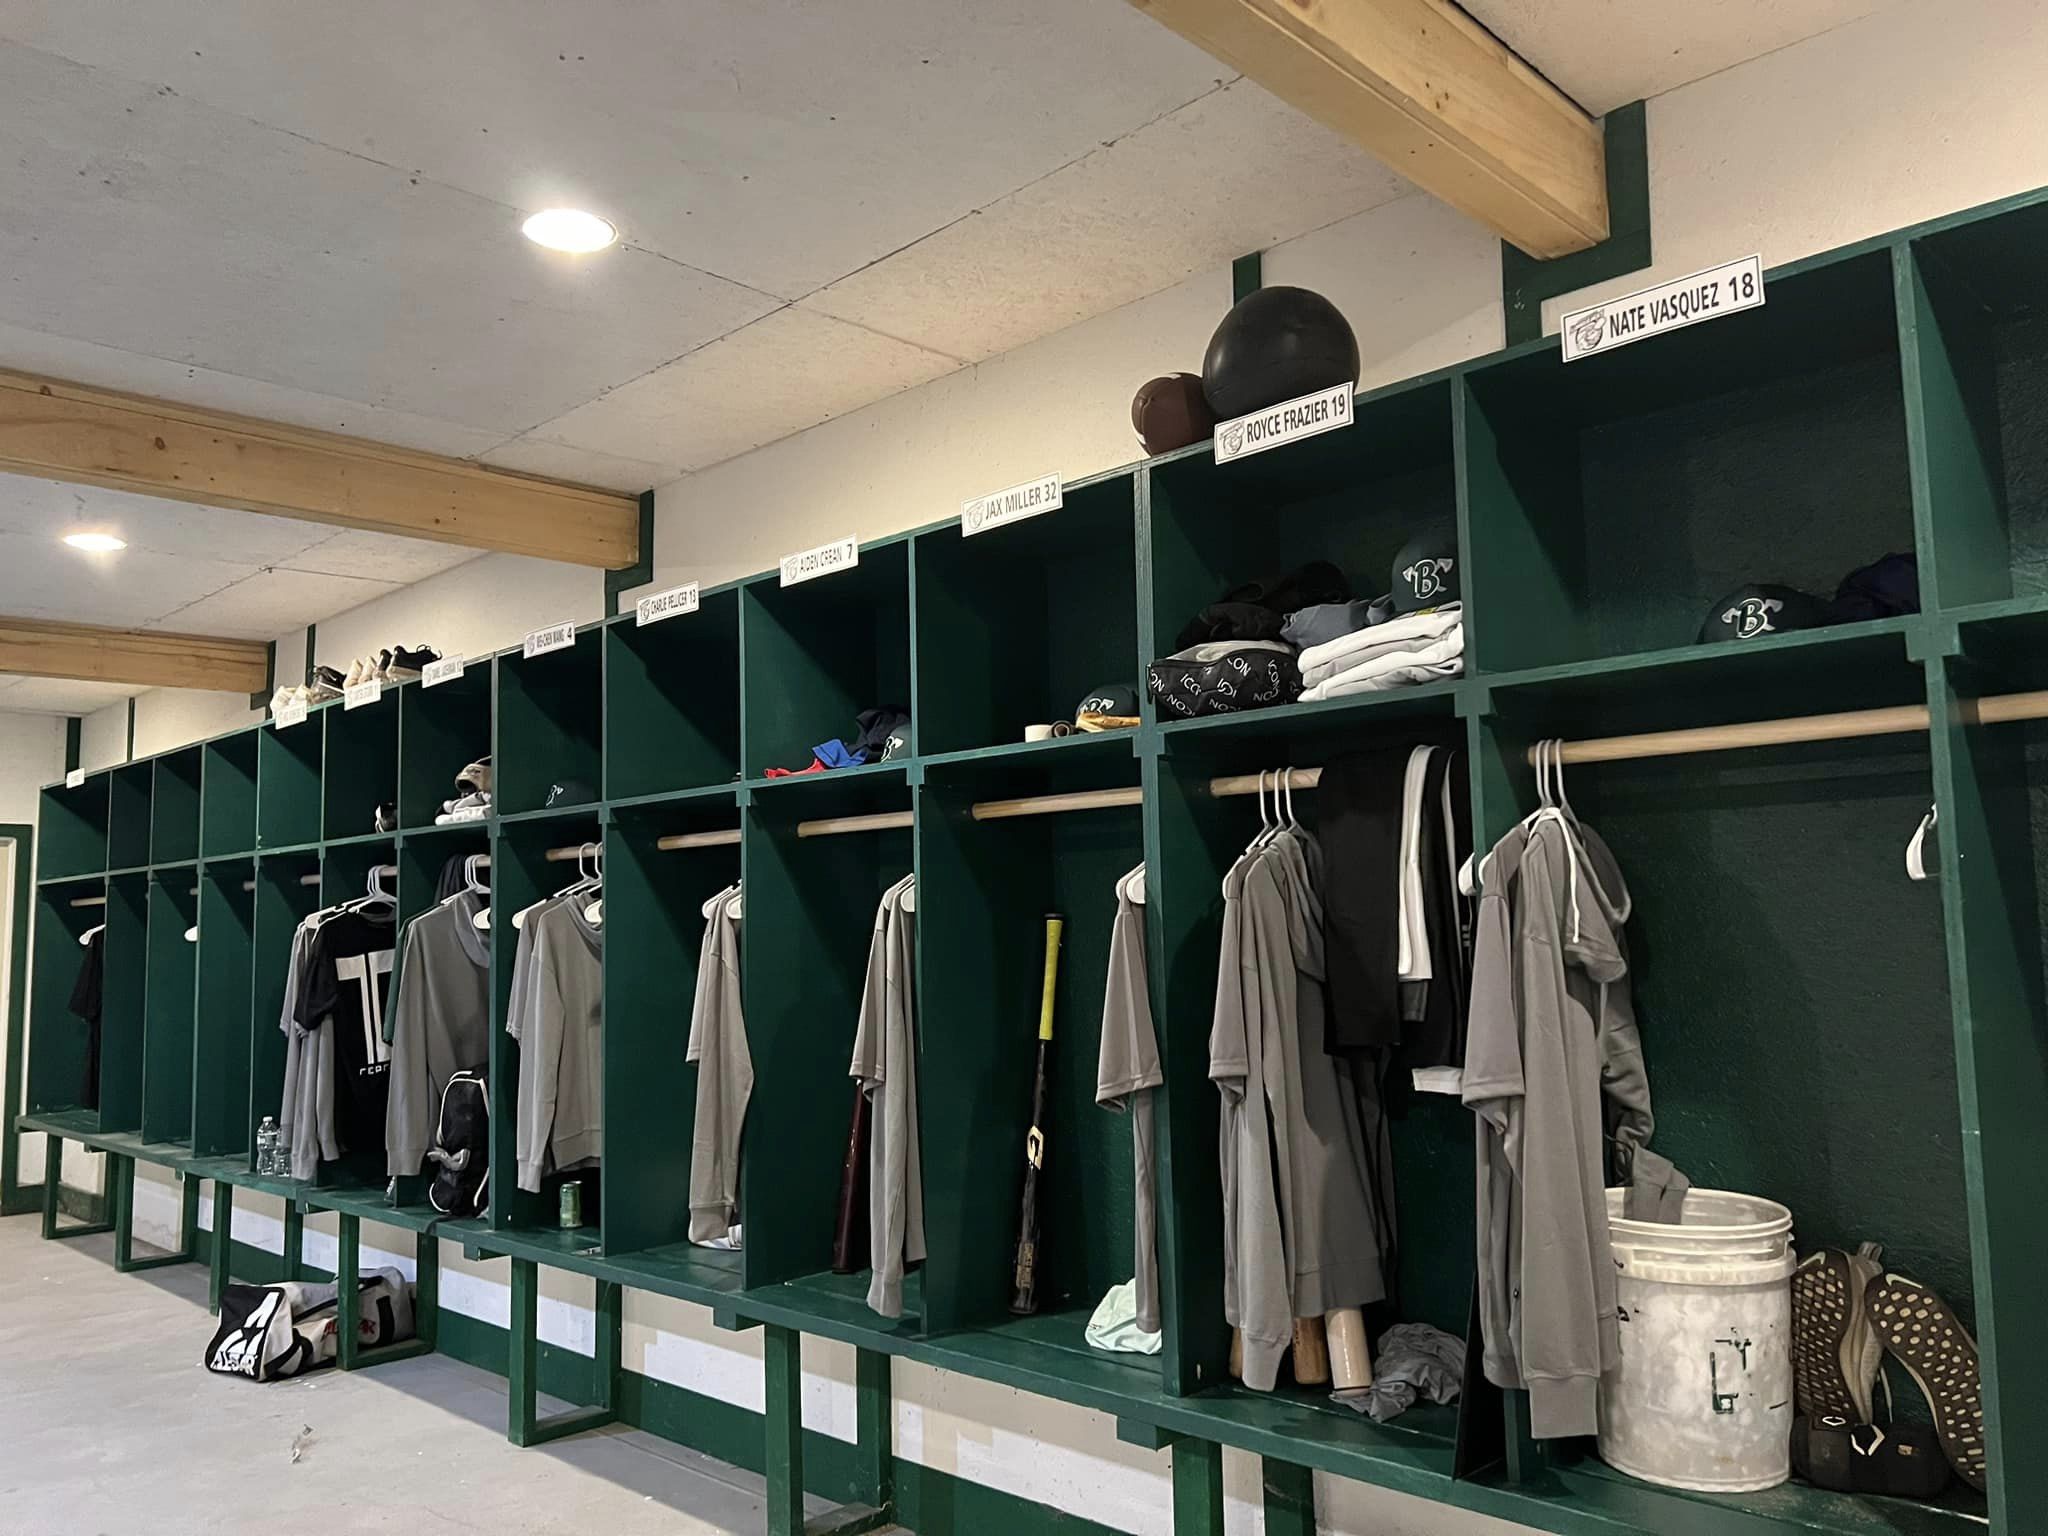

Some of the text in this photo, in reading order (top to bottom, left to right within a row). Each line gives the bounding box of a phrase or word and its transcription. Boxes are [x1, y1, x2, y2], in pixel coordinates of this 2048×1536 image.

[1609, 272, 1754, 338] NATE VASQUEZ 18
[1246, 394, 1345, 443] ROYCE FRAZIER 19
[985, 481, 1057, 520] JAX MILLER 32
[847, 543, 853, 560] 7
[567, 626, 572, 640] 4
